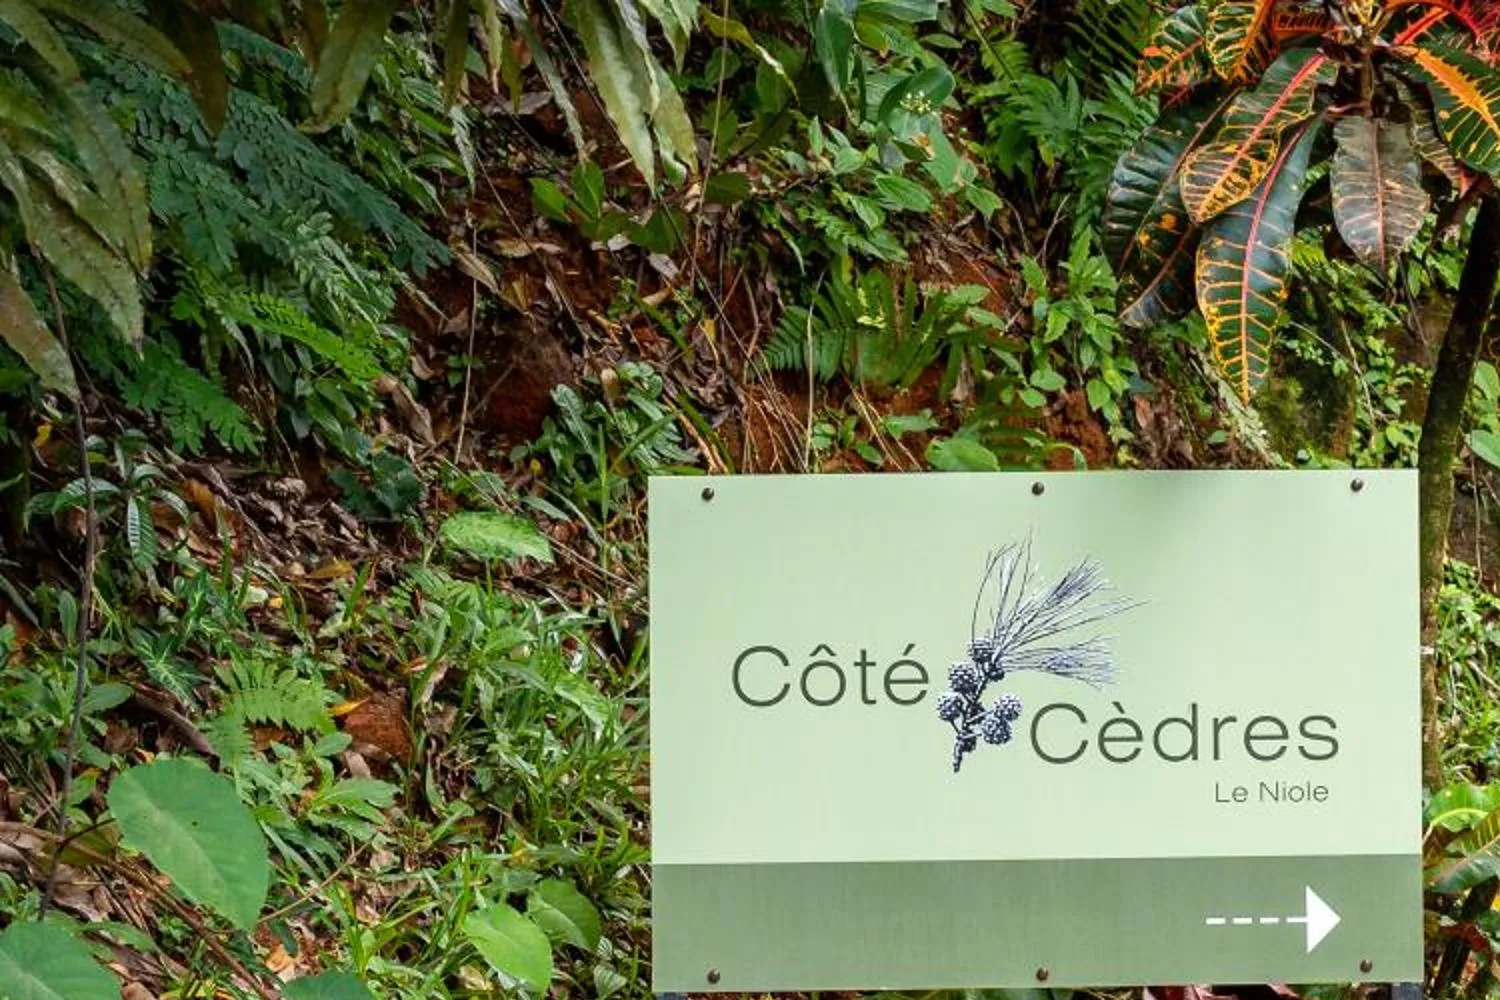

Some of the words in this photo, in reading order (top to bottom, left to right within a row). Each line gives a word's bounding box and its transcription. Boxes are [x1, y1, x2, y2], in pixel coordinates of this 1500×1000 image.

[731, 642, 930, 708] Côté
[1029, 701, 1340, 765] Cèdres
[1213, 781, 1249, 804] Le
[1258, 779, 1330, 803] Niole
